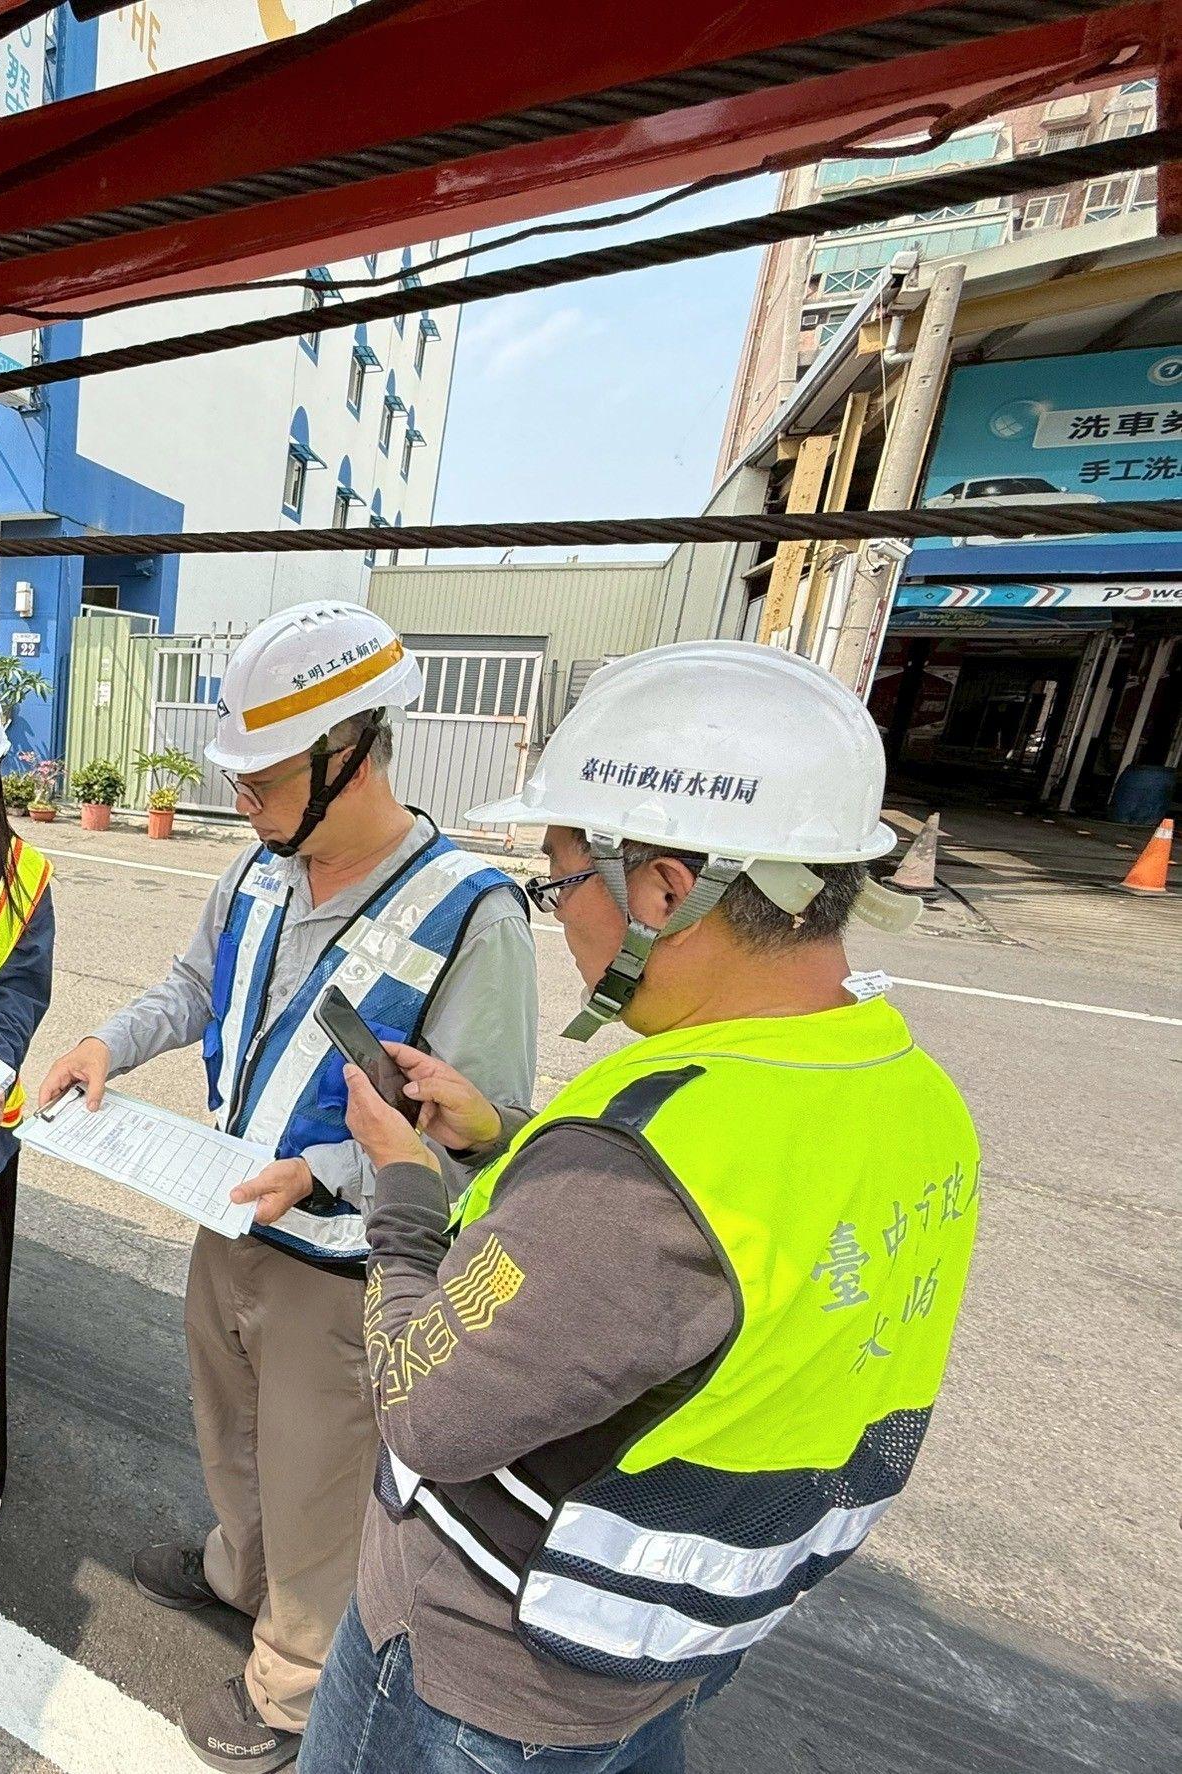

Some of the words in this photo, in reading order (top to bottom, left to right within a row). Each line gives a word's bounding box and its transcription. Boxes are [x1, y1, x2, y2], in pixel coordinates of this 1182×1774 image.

[1079, 455, 1182, 484] 手工洗
[20, 643, 36, 656] 22
[291, 637, 382, 690] 黎明工程顧問
[580, 757, 759, 805] 臺中市政府水利局
